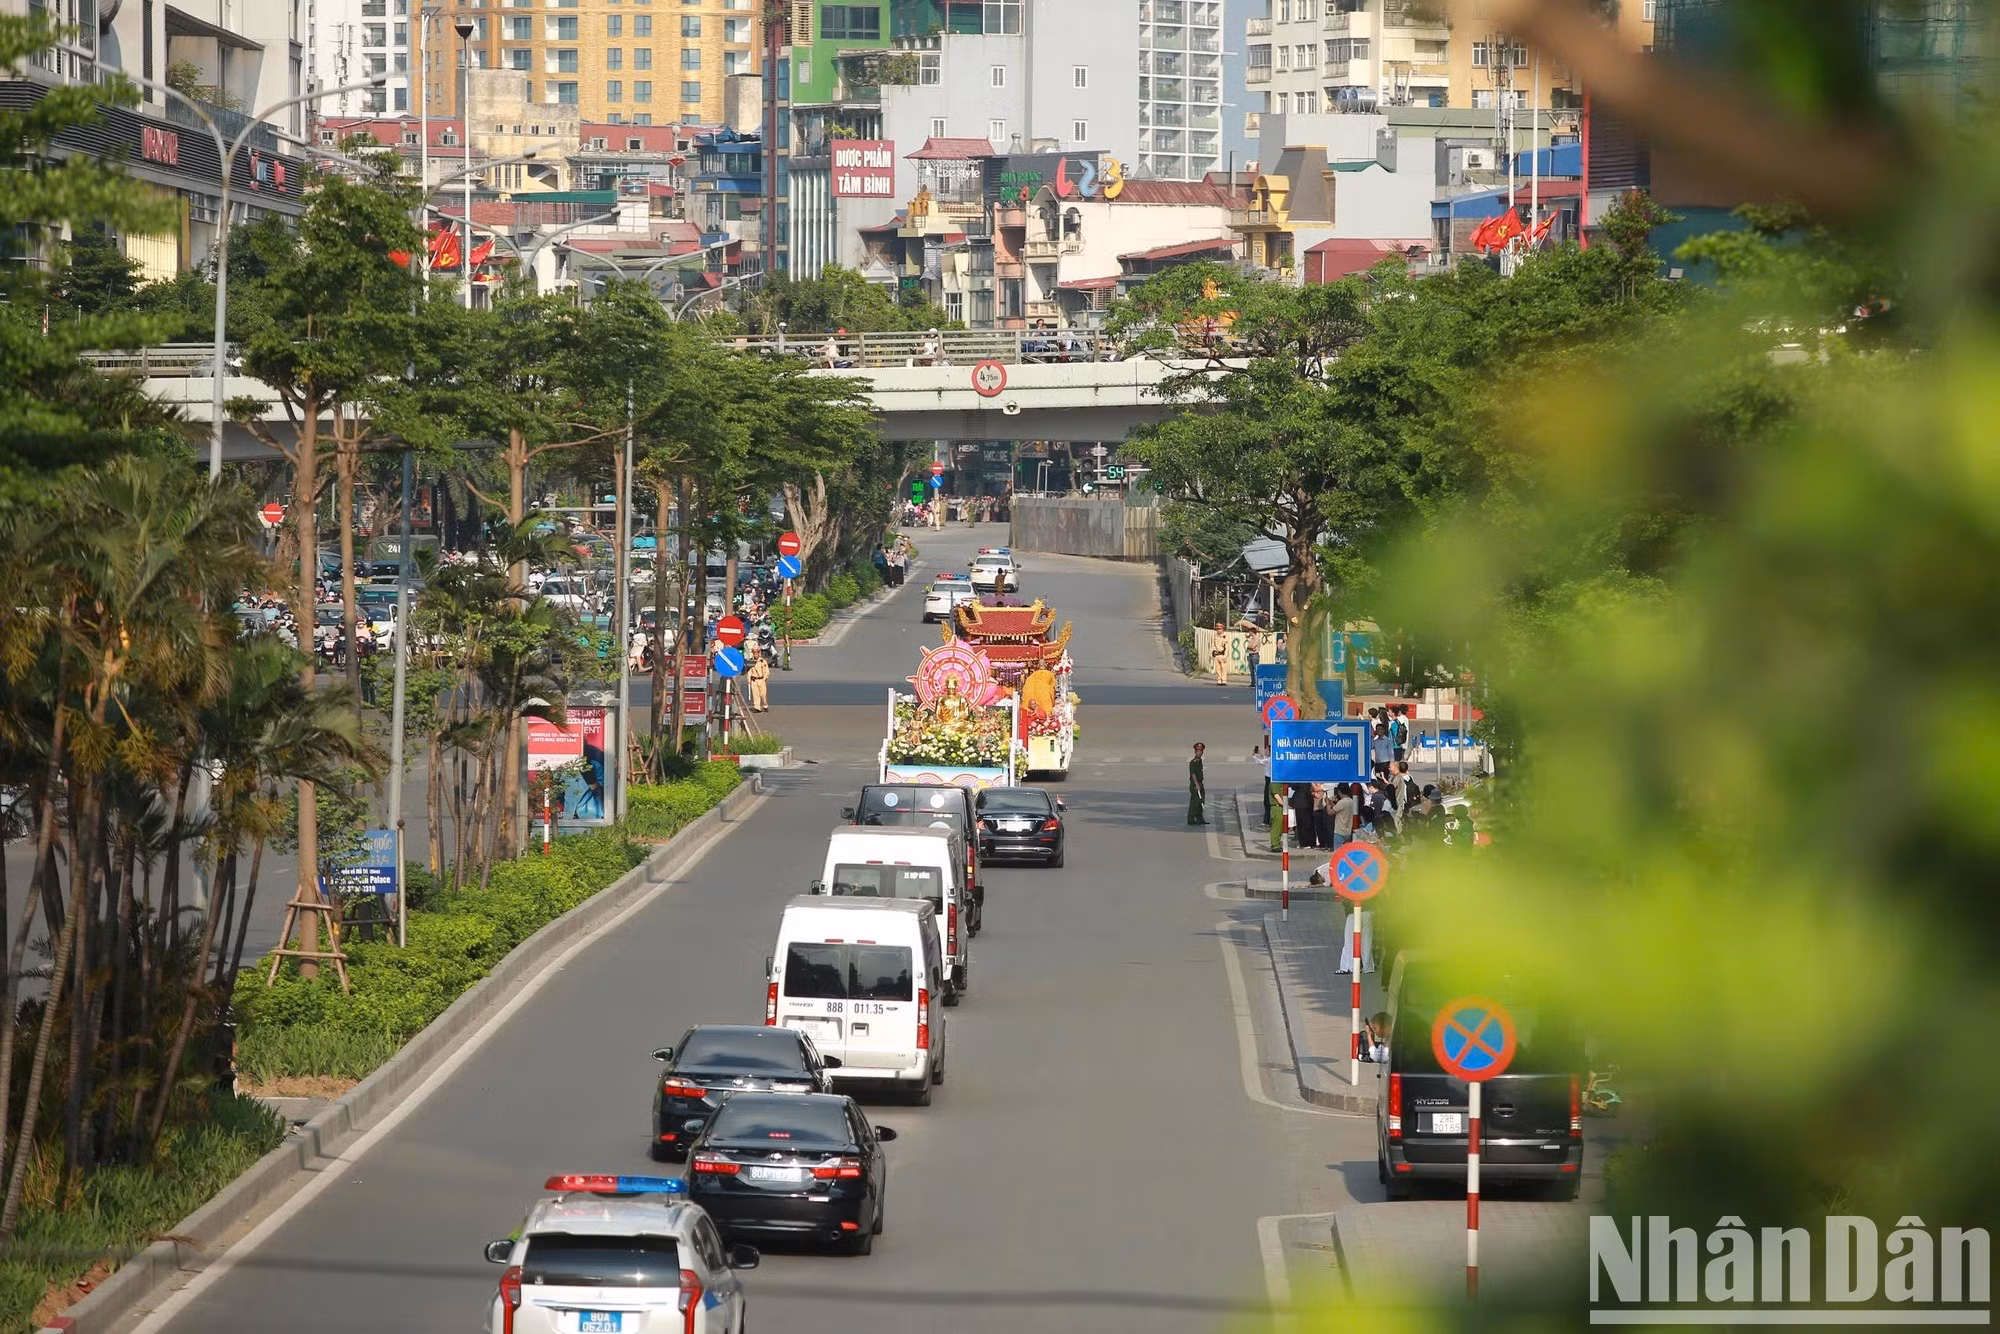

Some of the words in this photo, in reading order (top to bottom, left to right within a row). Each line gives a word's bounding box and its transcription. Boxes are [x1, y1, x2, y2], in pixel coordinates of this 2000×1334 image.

[836, 148, 861, 170] DƯỢC
[863, 143, 891, 168] PHẨM
[838, 172, 861, 194] TÂM
[863, 173, 890, 194] BÌNH
[1108, 466, 1124, 479] 54
[1277, 736, 1291, 748] NHÀ
[1293, 736, 1316, 748] KHÁCH
[1317, 739, 1327, 748] LA
[1328, 736, 1352, 748] THÀNH
[1275, 751, 1284, 760] La
[1285, 751, 1307, 760] Thanh
[1307, 751, 1327, 760] Guest
[1328, 751, 1349, 760] House
[369, 875, 391, 884] Palace
[826, 1002, 844, 1013] 88B
[854, 1003, 884, 1015] 011.35
[1439, 1114, 1454, 1123] 29B
